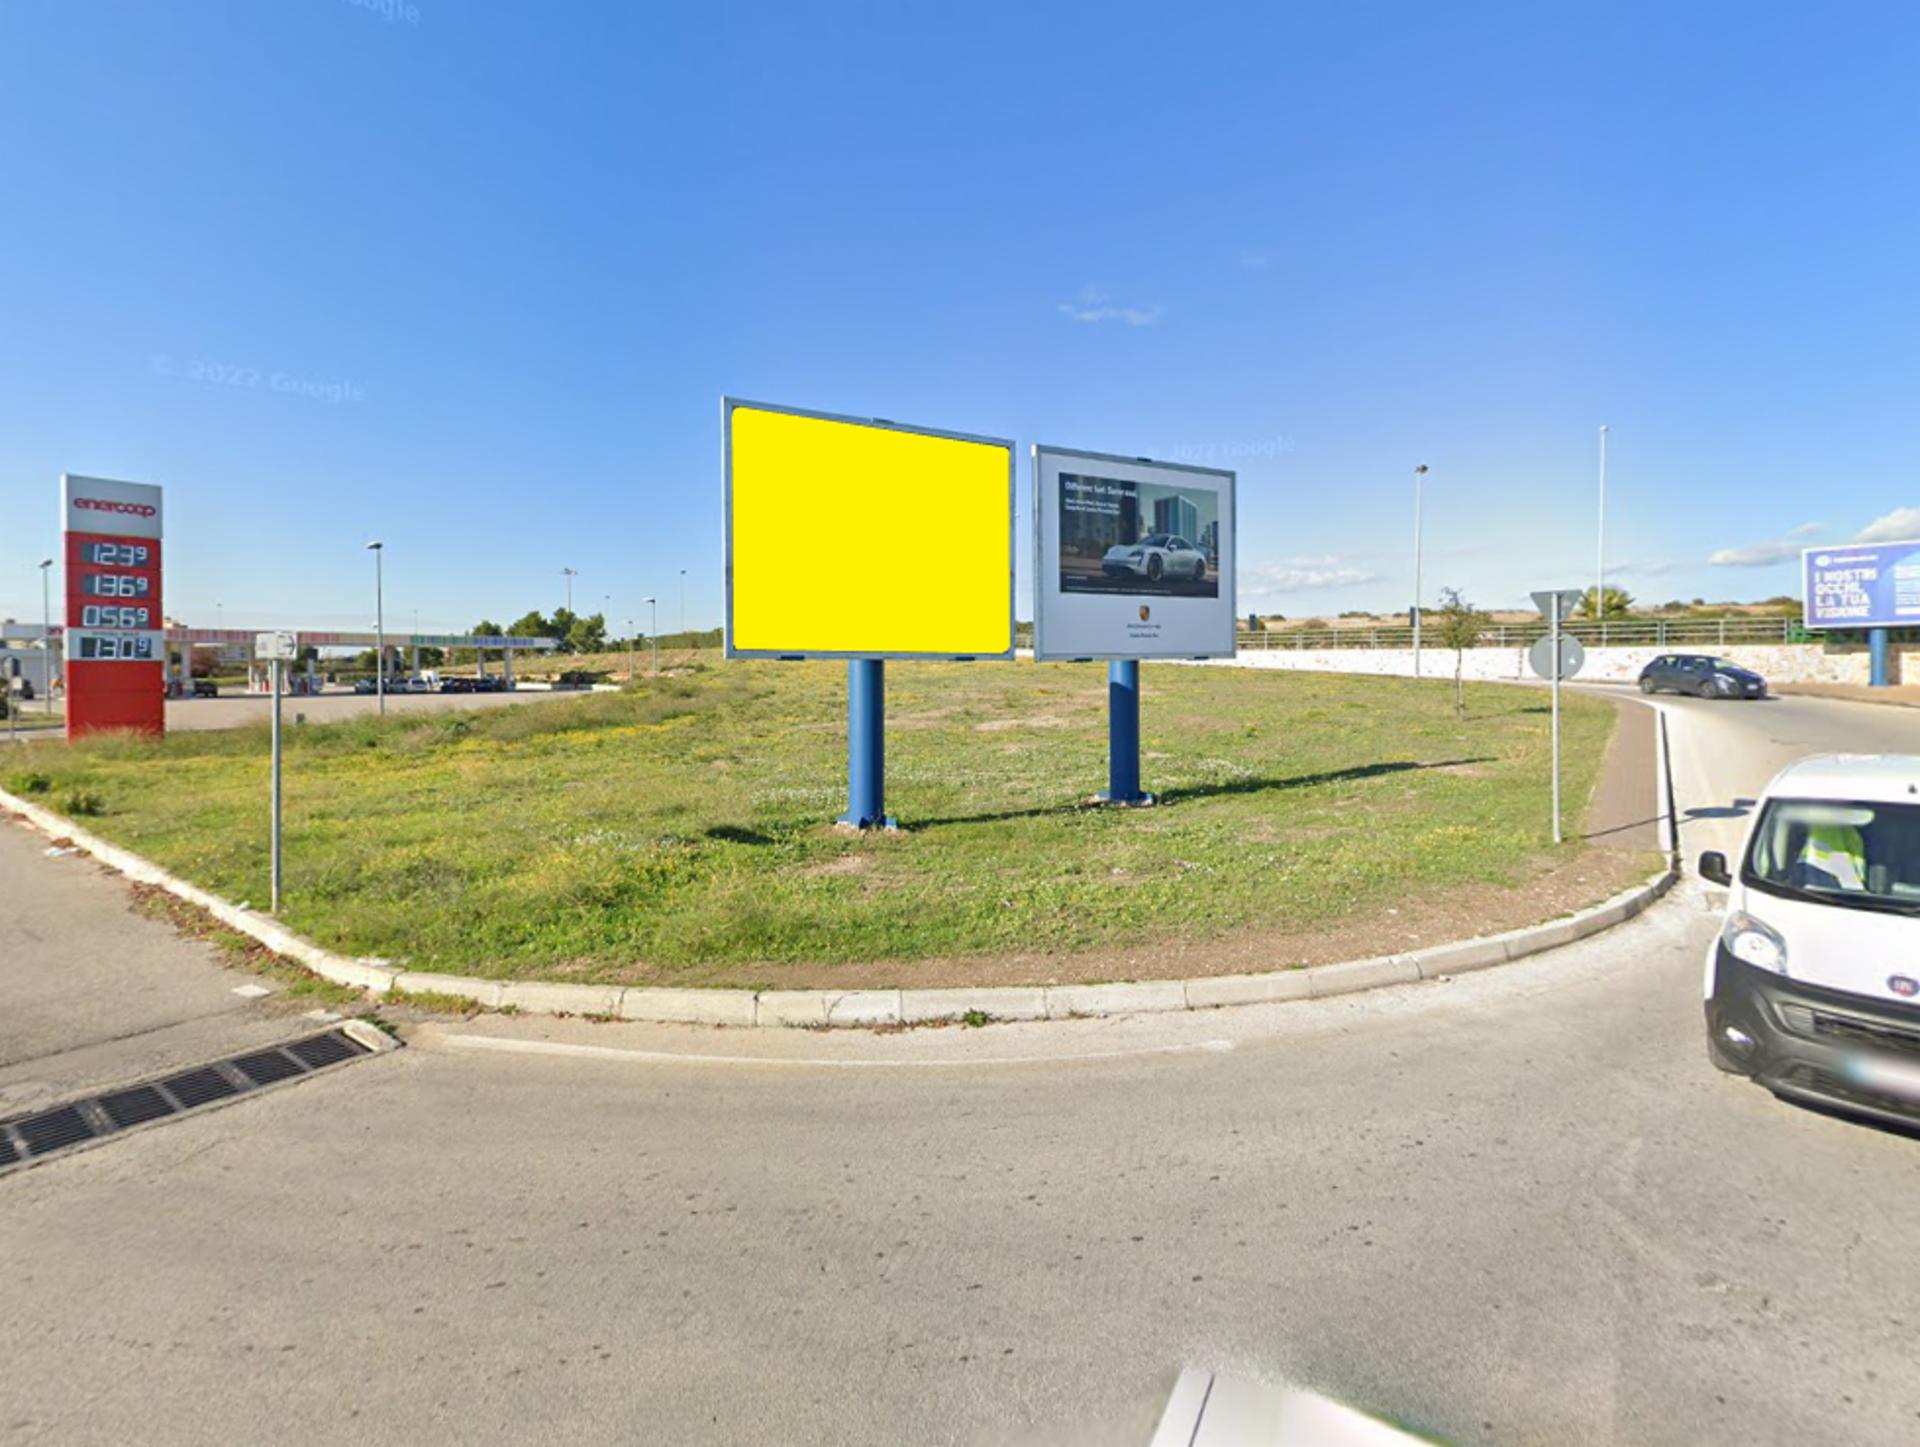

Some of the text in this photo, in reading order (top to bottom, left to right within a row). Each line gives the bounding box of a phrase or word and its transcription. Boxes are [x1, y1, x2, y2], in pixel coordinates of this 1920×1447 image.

[74, 498, 156, 518] enercoop
[1823, 569, 1877, 583] NOSTRI
[1815, 592, 1871, 606] LA TUA
